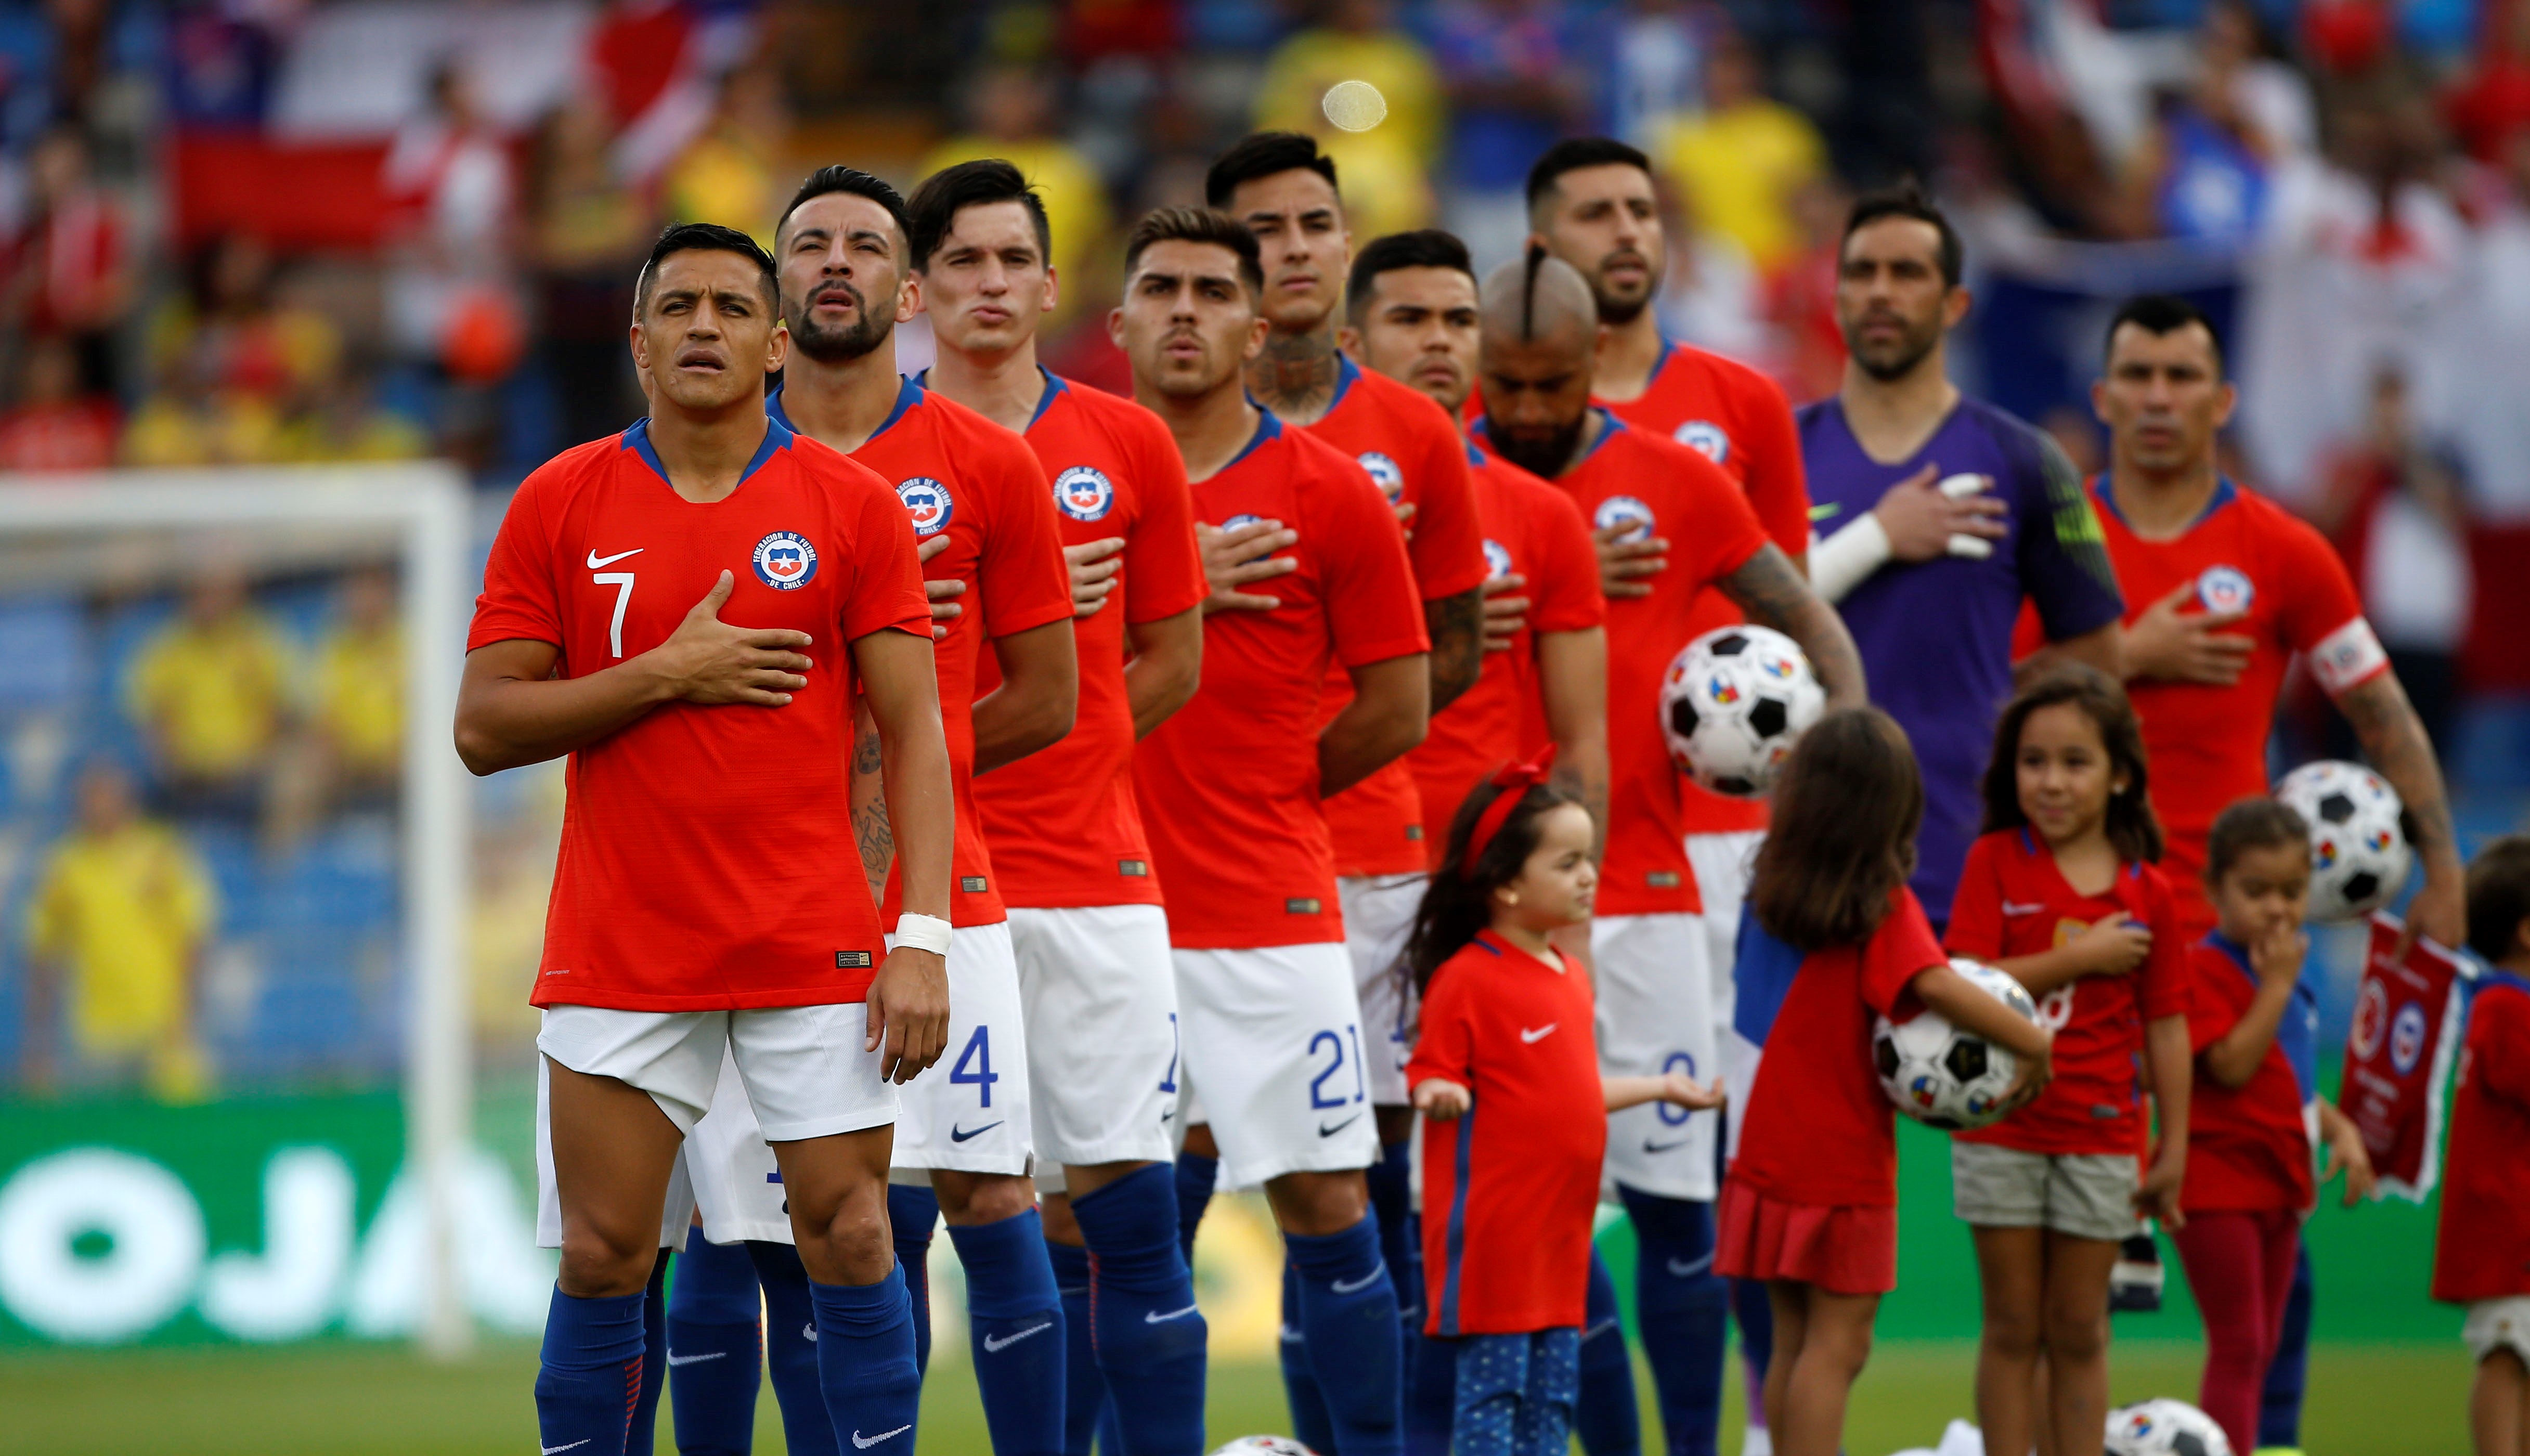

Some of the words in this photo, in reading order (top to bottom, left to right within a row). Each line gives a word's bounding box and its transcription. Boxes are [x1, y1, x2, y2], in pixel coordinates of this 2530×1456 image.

[924, 478, 933, 487] DE
[935, 483, 952, 508] FUTBOL
[919, 525, 939, 535] CHILE
[752, 532, 783, 563] FEDERACION
[788, 532, 798, 541] DE
[799, 538, 817, 562] FUTBOL
[769, 579, 780, 589] DE
[783, 579, 803, 590] CHILE
[593, 572, 635, 658] 7
[950, 1025, 998, 1108] 4
[1308, 1024, 1363, 1109] 21
